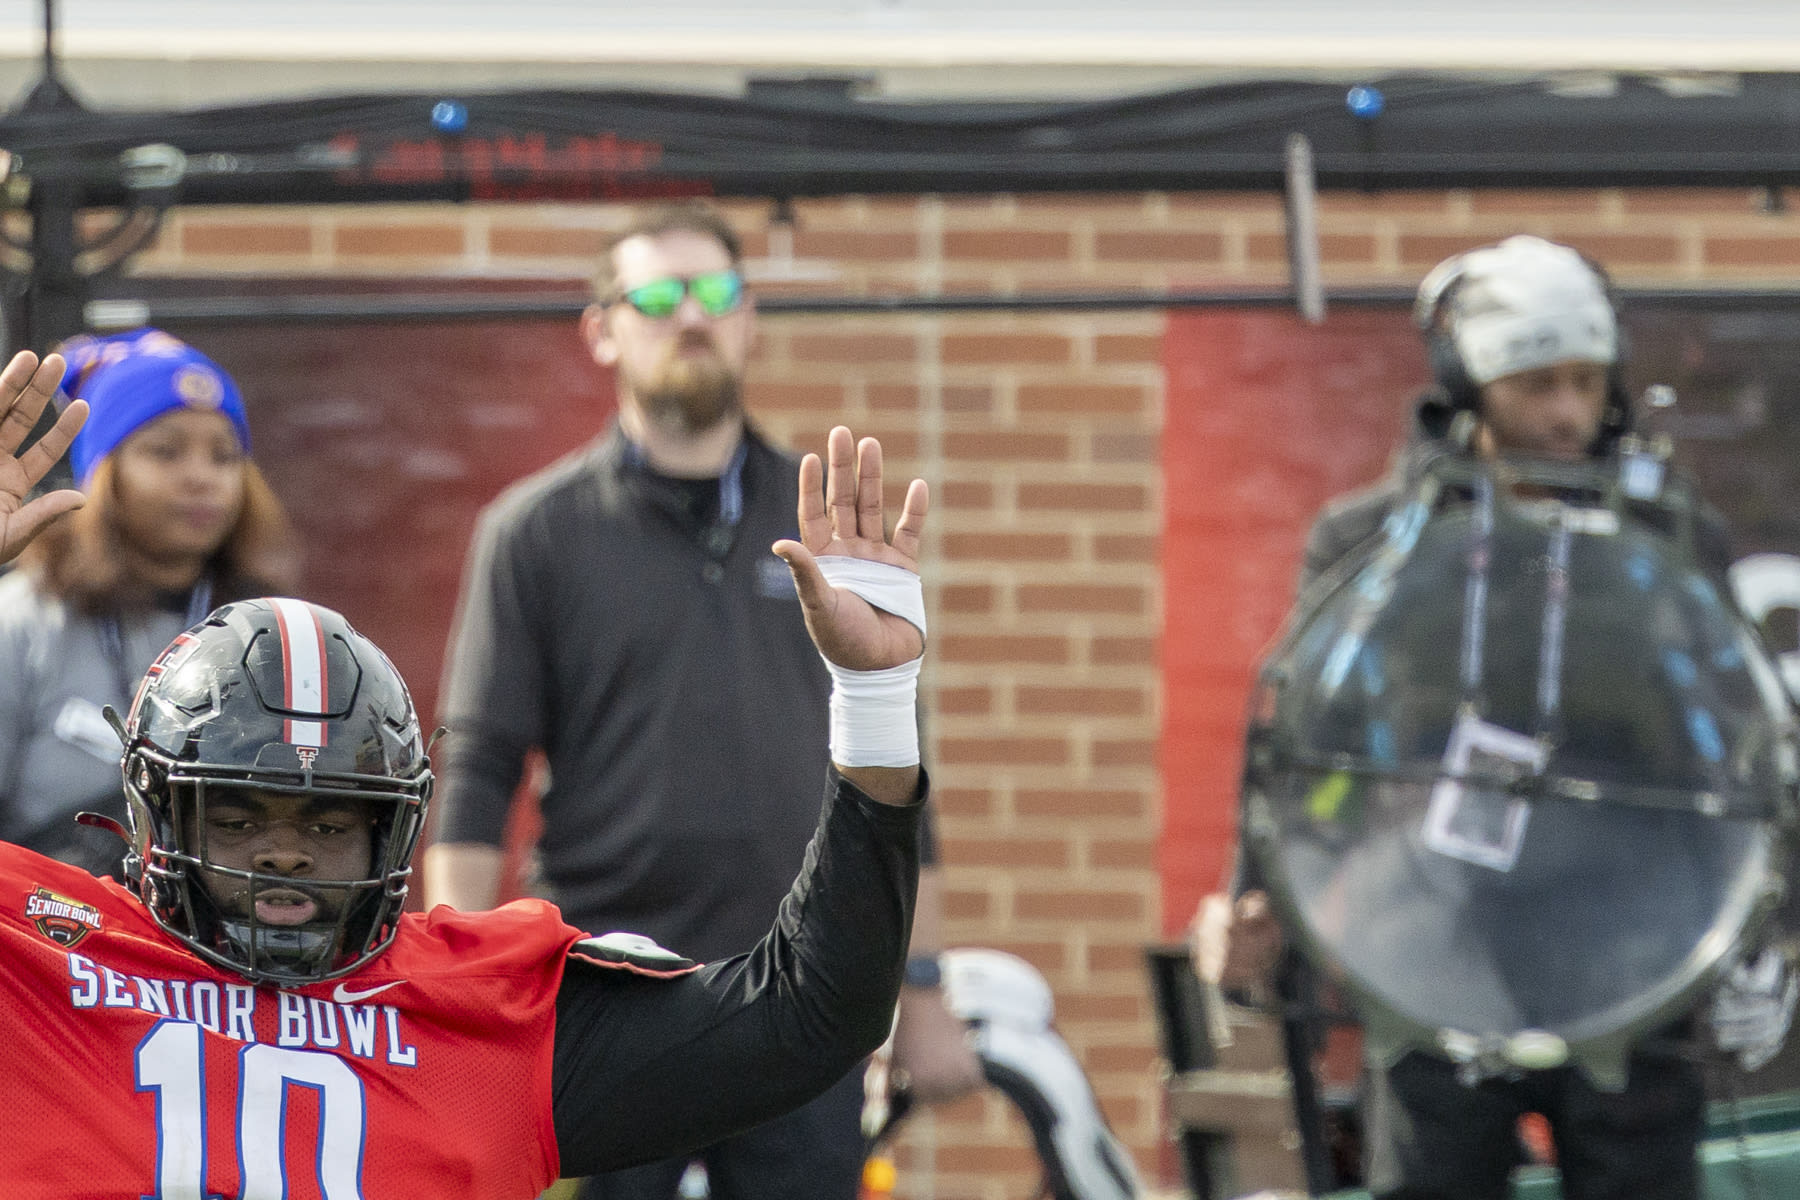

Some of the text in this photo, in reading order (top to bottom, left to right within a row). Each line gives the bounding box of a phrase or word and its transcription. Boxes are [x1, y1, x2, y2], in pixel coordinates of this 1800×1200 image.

[26, 895, 70, 918] SENIOR
[70, 908, 101, 929] BOWL
[67, 952, 418, 1068] SENIOR BOWL
